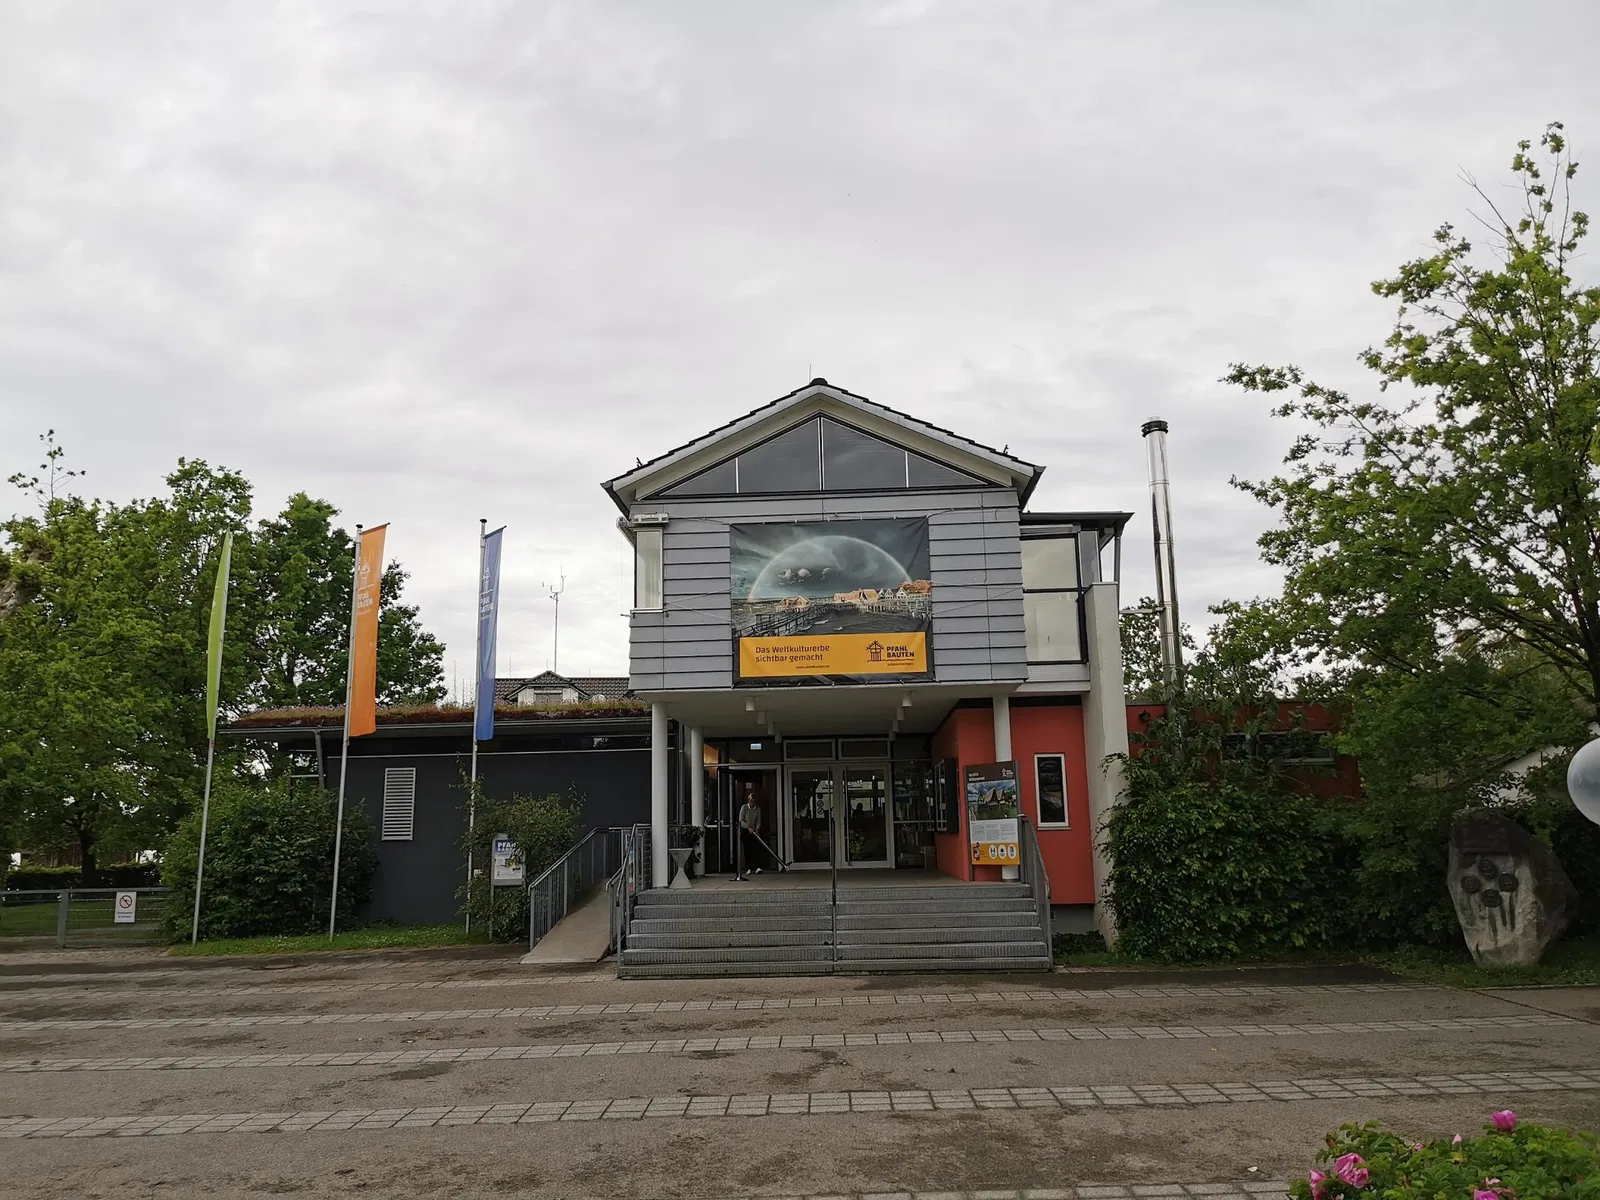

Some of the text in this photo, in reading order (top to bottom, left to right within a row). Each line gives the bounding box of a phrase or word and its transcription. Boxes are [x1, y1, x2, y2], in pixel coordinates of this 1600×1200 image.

[755, 644, 830, 654] Das Weltkulturerbe
[755, 653, 823, 663] sichtbar gemacht
